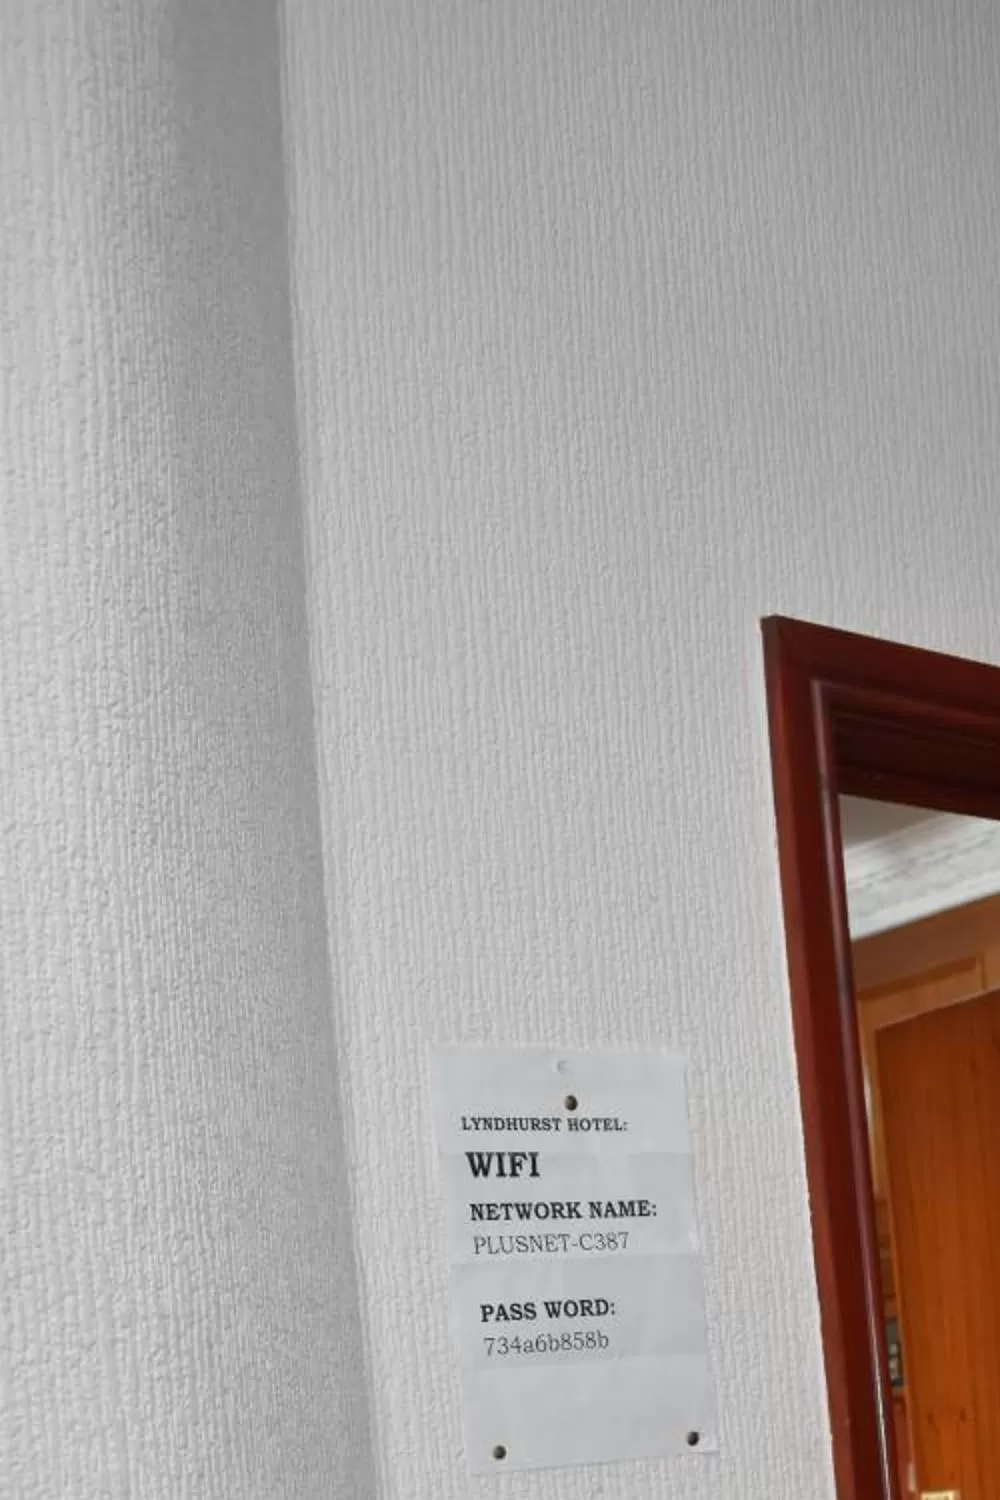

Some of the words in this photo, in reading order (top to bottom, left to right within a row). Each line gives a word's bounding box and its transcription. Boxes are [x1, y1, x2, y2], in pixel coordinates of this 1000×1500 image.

[461, 1117, 561, 1132] LYNDHURST
[568, 1117, 629, 1132] HOTEL:
[466, 1151, 540, 1178] WIFI
[470, 1202, 581, 1221] NETWORK
[589, 1200, 657, 1219] NAME:
[473, 1232, 629, 1255] PLUSNET-C387
[480, 1303, 537, 1322] PASS
[544, 1299, 615, 1319] WORD:
[484, 1330, 609, 1356] 734a6b858b
